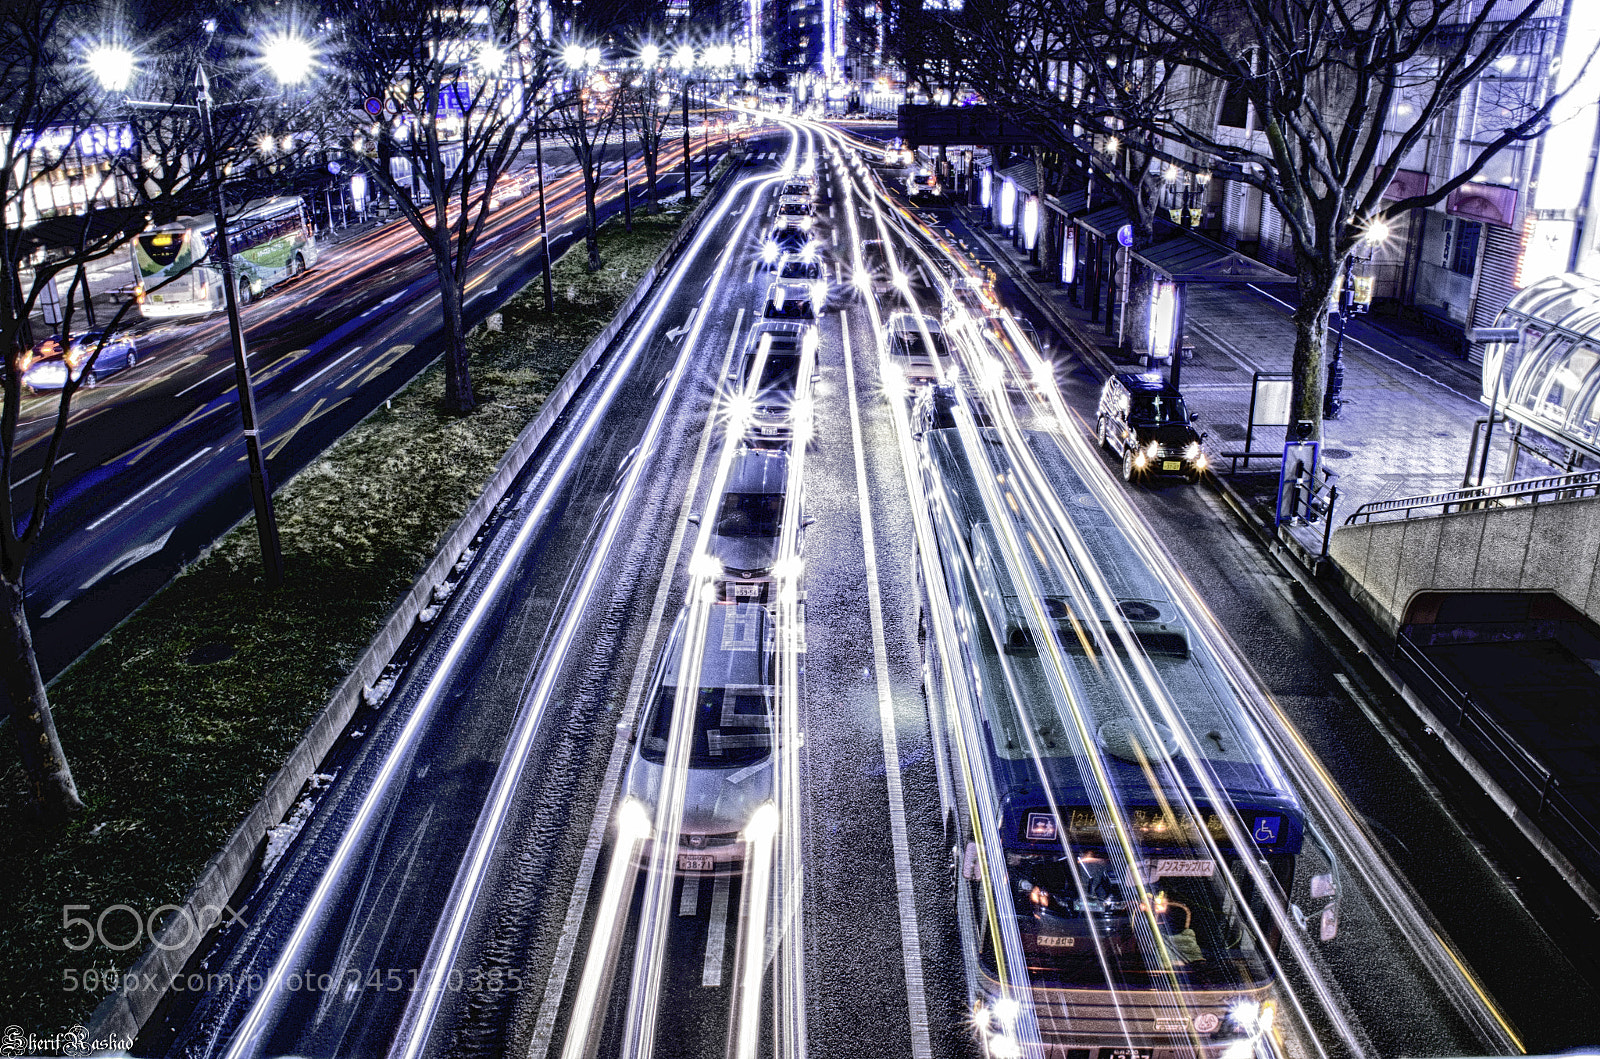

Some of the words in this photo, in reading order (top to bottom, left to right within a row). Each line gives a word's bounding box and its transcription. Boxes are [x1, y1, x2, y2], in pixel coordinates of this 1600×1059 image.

[687, 861, 711, 869] 38-71
[1159, 861, 1211, 872] ノンステップバス
